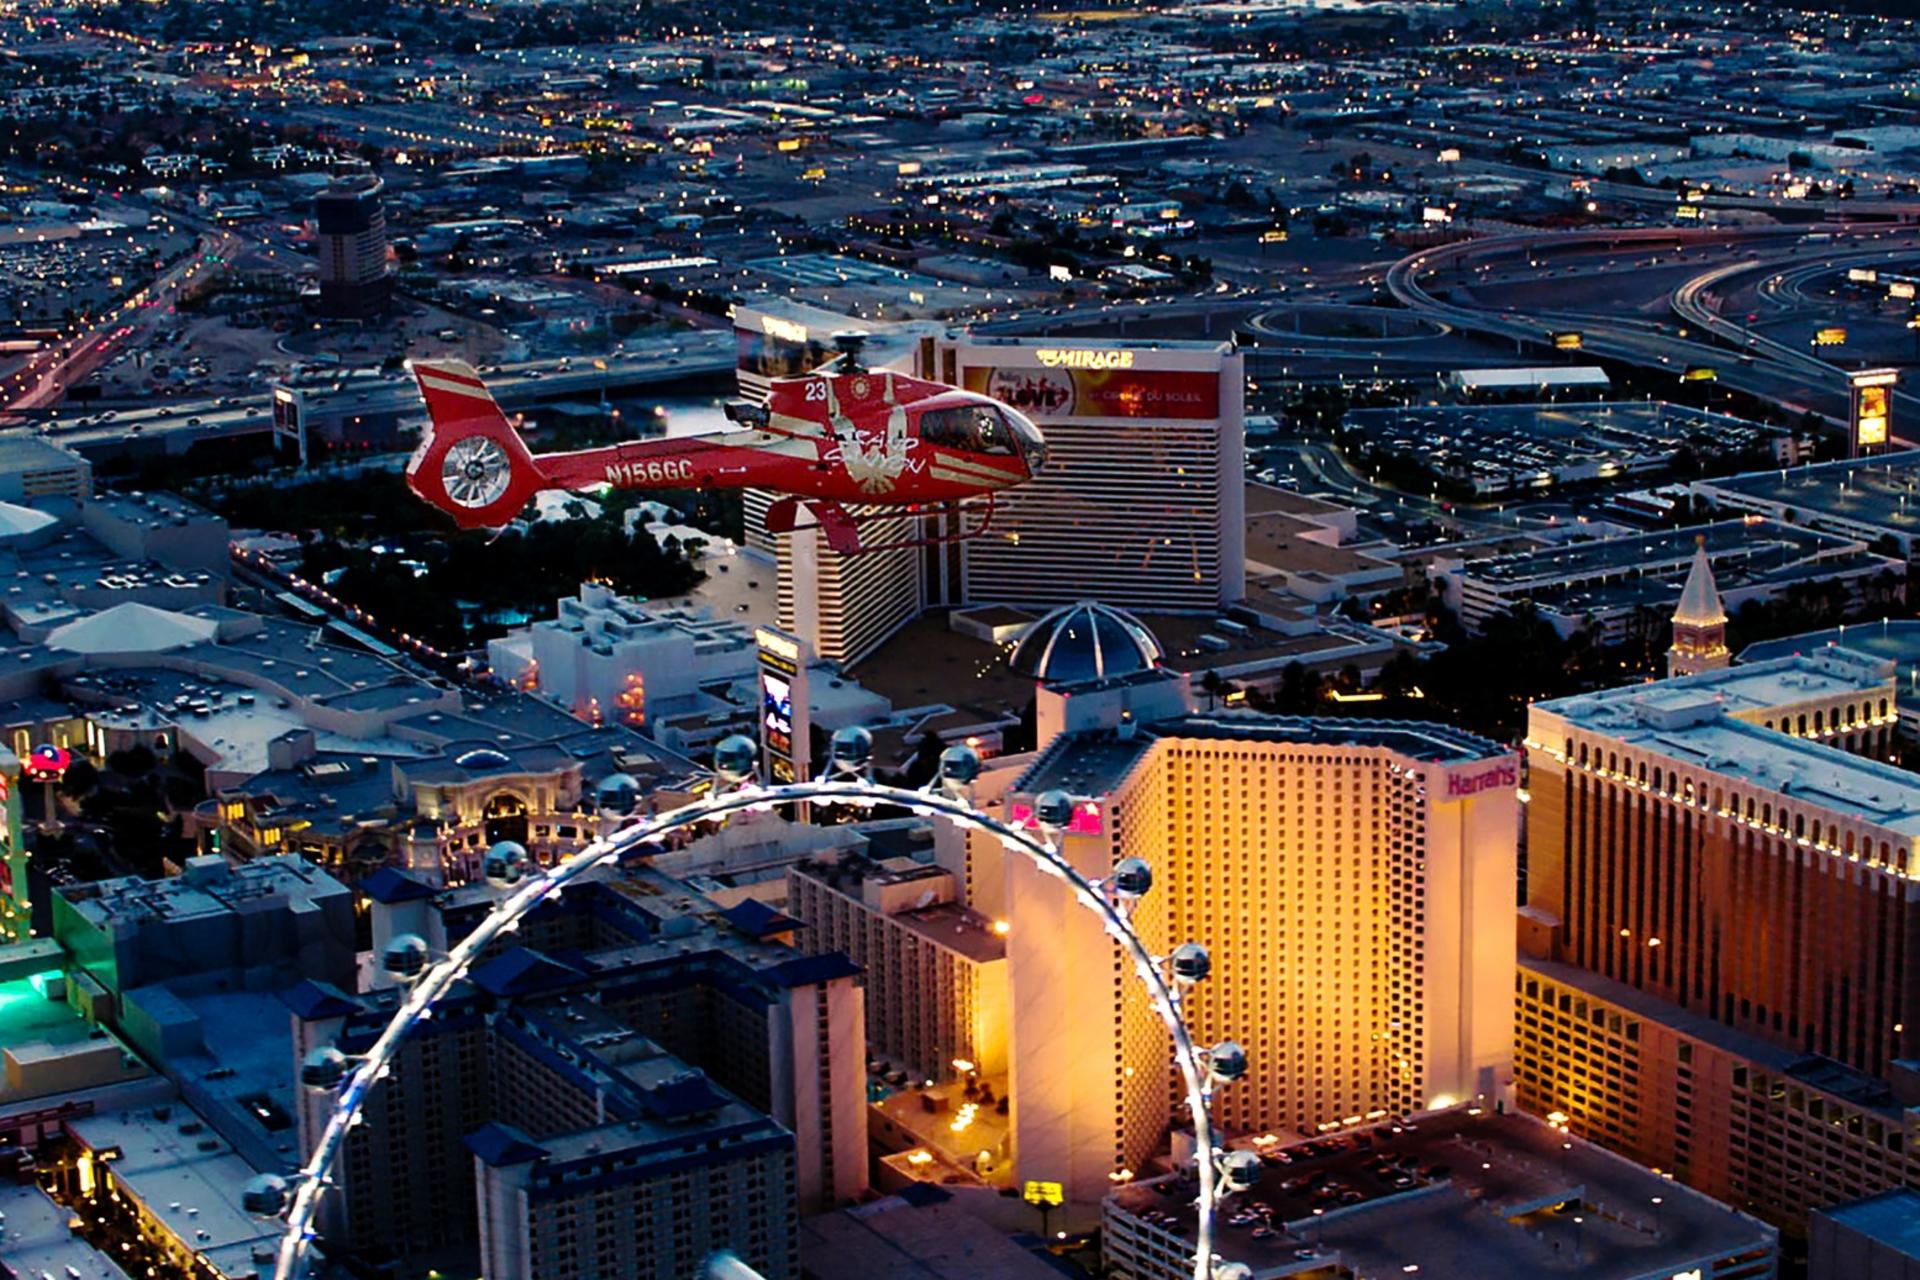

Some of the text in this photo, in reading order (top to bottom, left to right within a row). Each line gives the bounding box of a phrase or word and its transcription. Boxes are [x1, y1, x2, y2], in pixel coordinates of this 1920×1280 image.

[1059, 350, 1134, 369] MIRAGE
[805, 382, 827, 401] 23
[605, 459, 694, 484] N156GC
